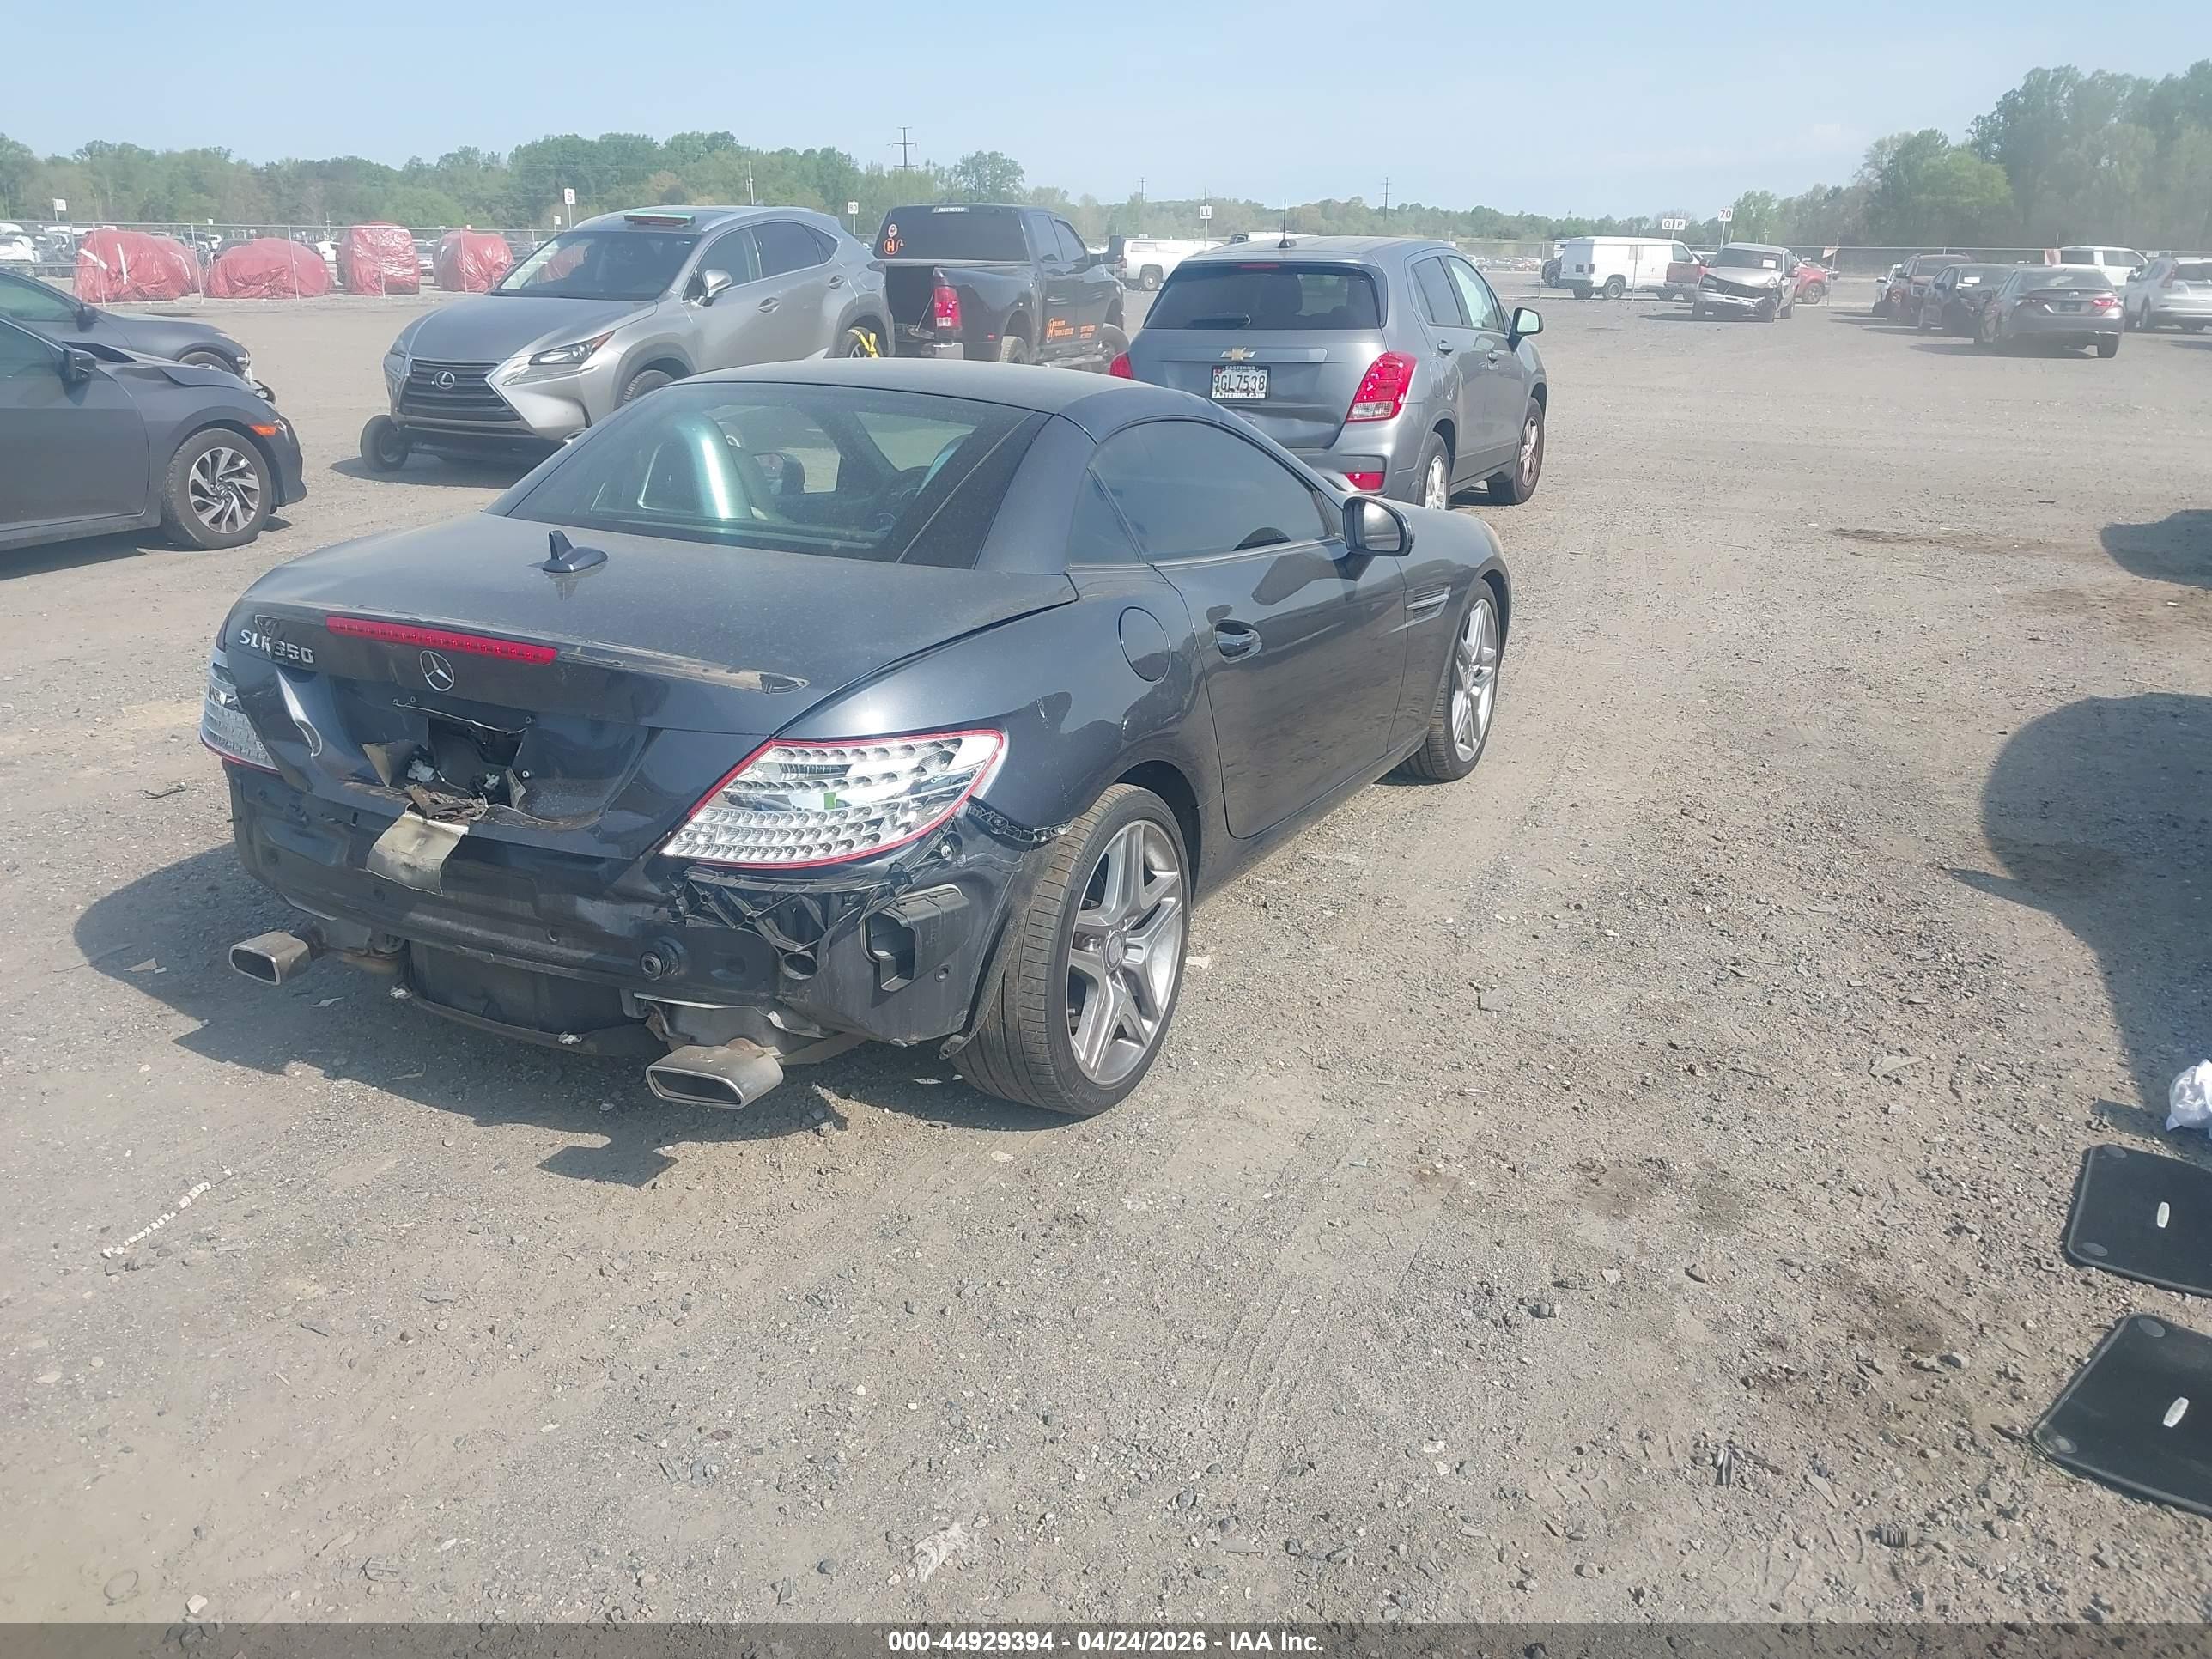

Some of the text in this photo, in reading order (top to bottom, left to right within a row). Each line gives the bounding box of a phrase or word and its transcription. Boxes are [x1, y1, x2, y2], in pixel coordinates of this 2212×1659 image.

[567, 191, 573, 202] S
[1201, 208, 1210, 216] LL
[1720, 210, 1732, 219] 70
[1663, 220, 1671, 228] Q
[1213, 374, 1266, 392] 9GL7538
[239, 629, 272, 654] SLK
